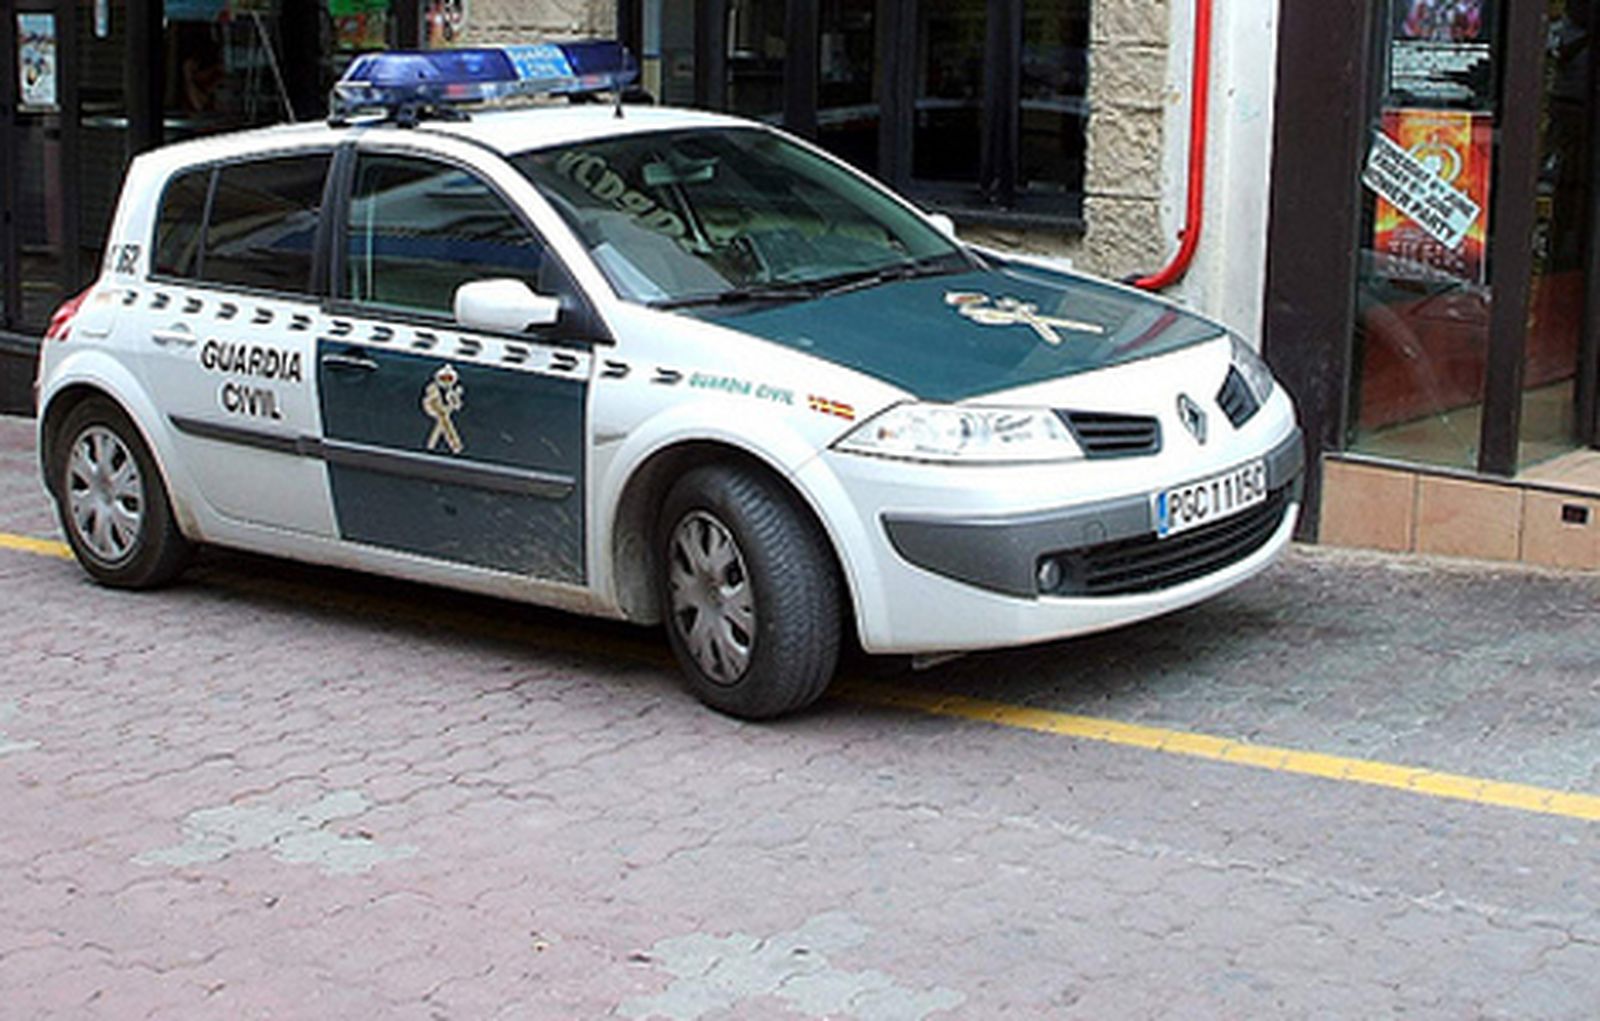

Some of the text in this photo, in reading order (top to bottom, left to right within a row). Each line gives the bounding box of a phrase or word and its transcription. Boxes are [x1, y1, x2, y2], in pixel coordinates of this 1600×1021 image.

[1409, 200, 1458, 241] PARTY
[201, 339, 302, 382] GUARDIA
[221, 382, 282, 420] CIVIL
